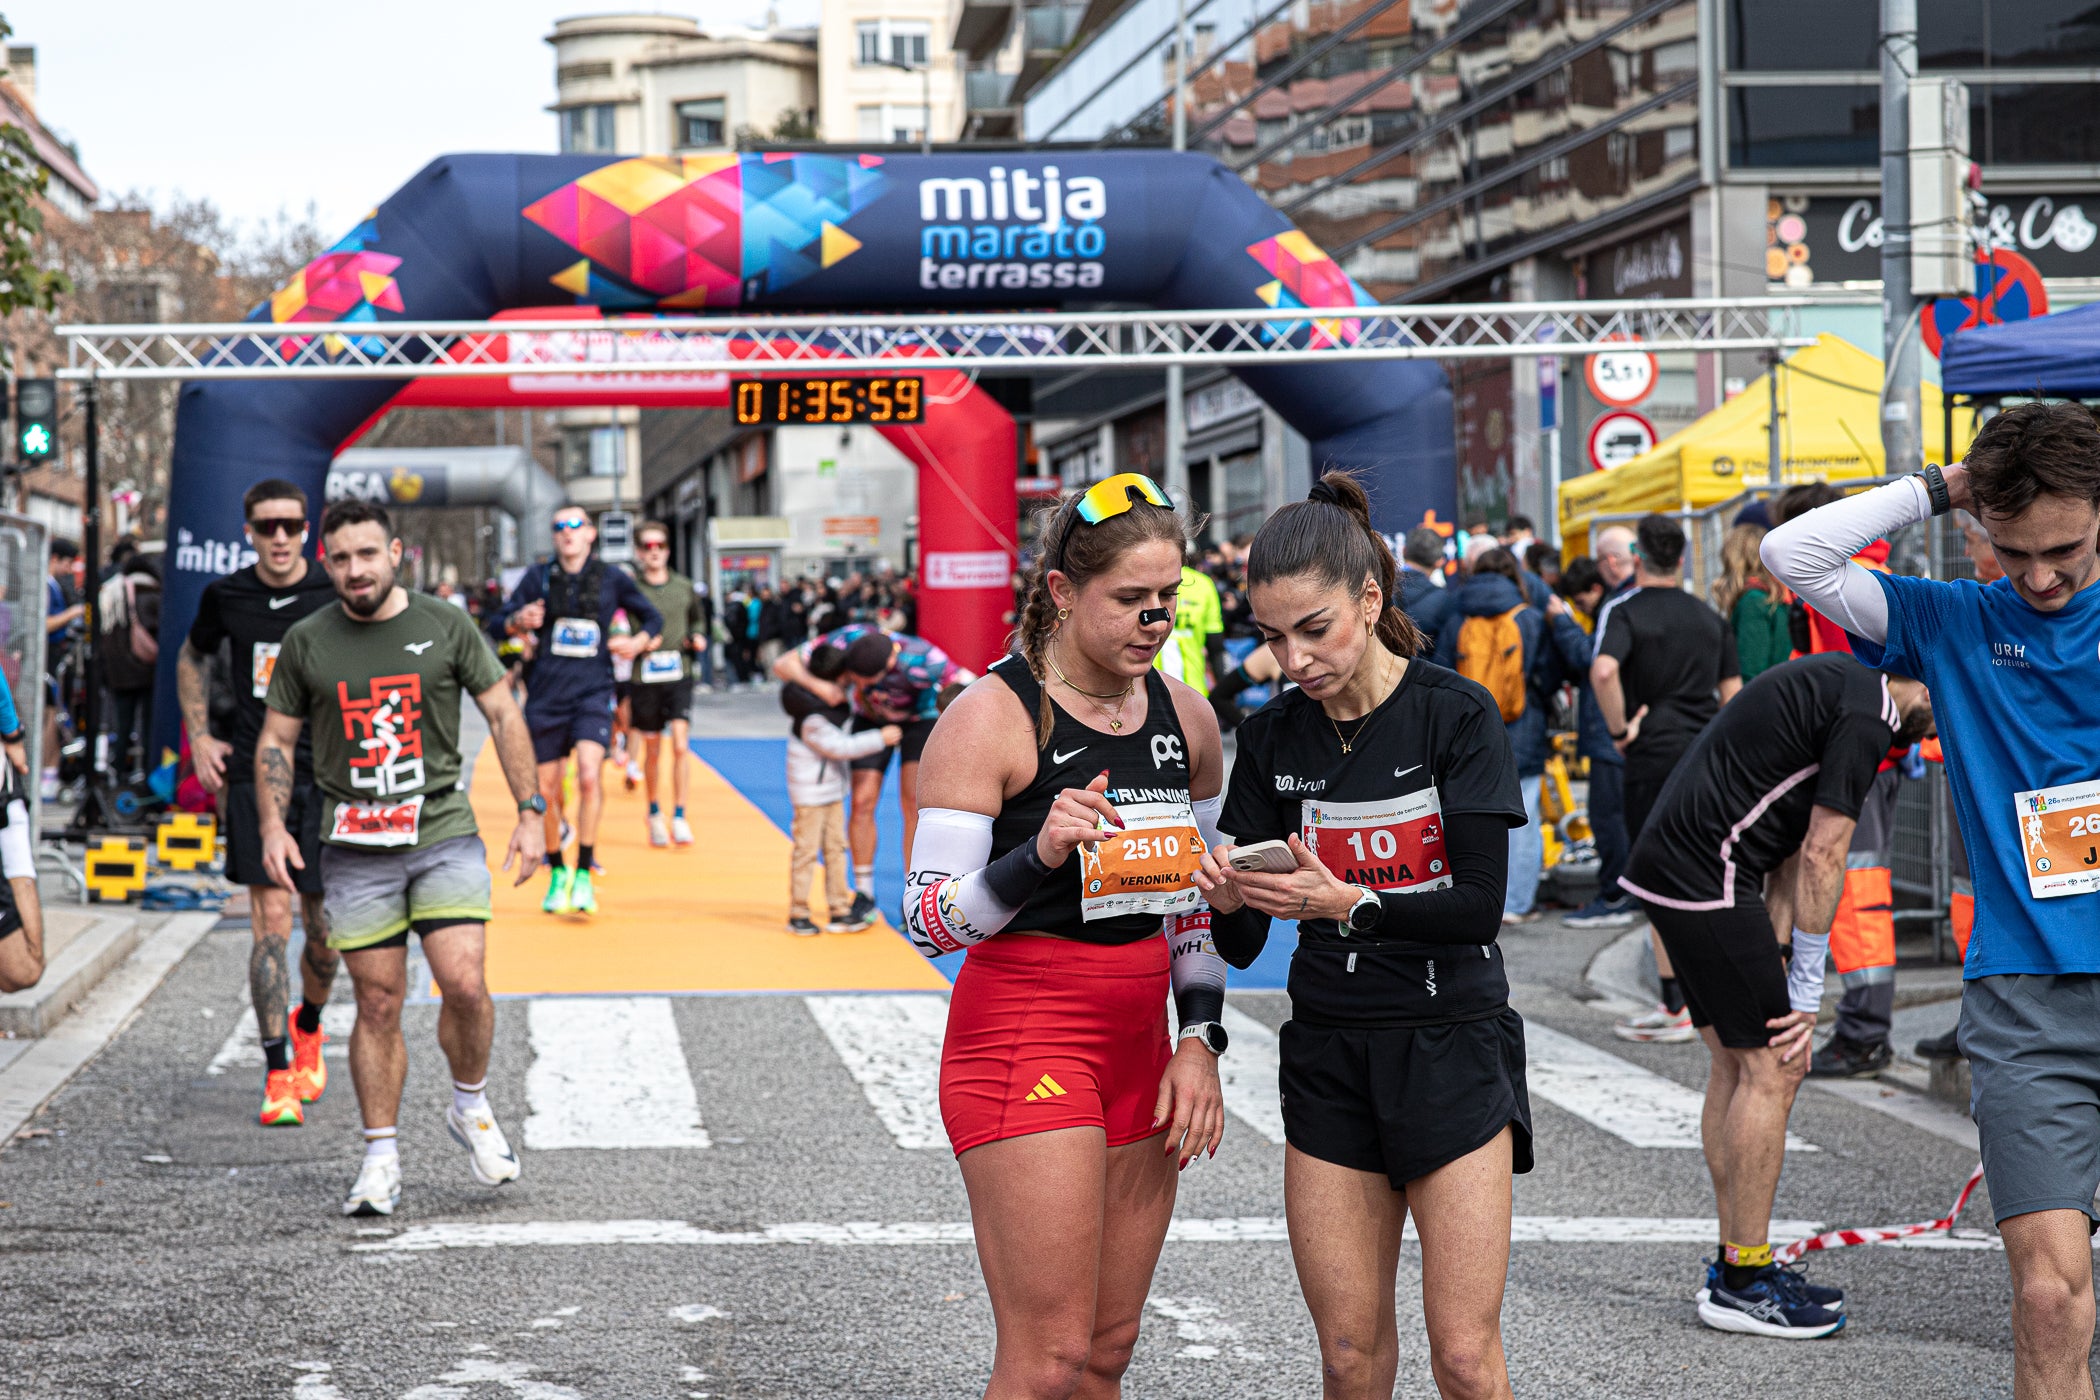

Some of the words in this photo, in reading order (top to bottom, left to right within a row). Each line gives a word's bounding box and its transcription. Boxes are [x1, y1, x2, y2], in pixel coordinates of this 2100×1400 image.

[919, 166, 1107, 234] mitja
[921, 216, 1107, 259] marató
[919, 257, 1105, 289] terrassa
[737, 379, 921, 424] 01:35:59
[325, 471, 389, 501] RSA
[1994, 642, 2026, 658] URH
[1104, 788, 1190, 804] 4RUNNING
[1296, 777, 1326, 791] i-run
[1122, 835, 1179, 861] 2510
[1347, 829, 1397, 862] 10
[1120, 872, 1181, 886] VERONIKA
[1344, 863, 1415, 885] ANNA
[1426, 959, 1436, 980] weis
